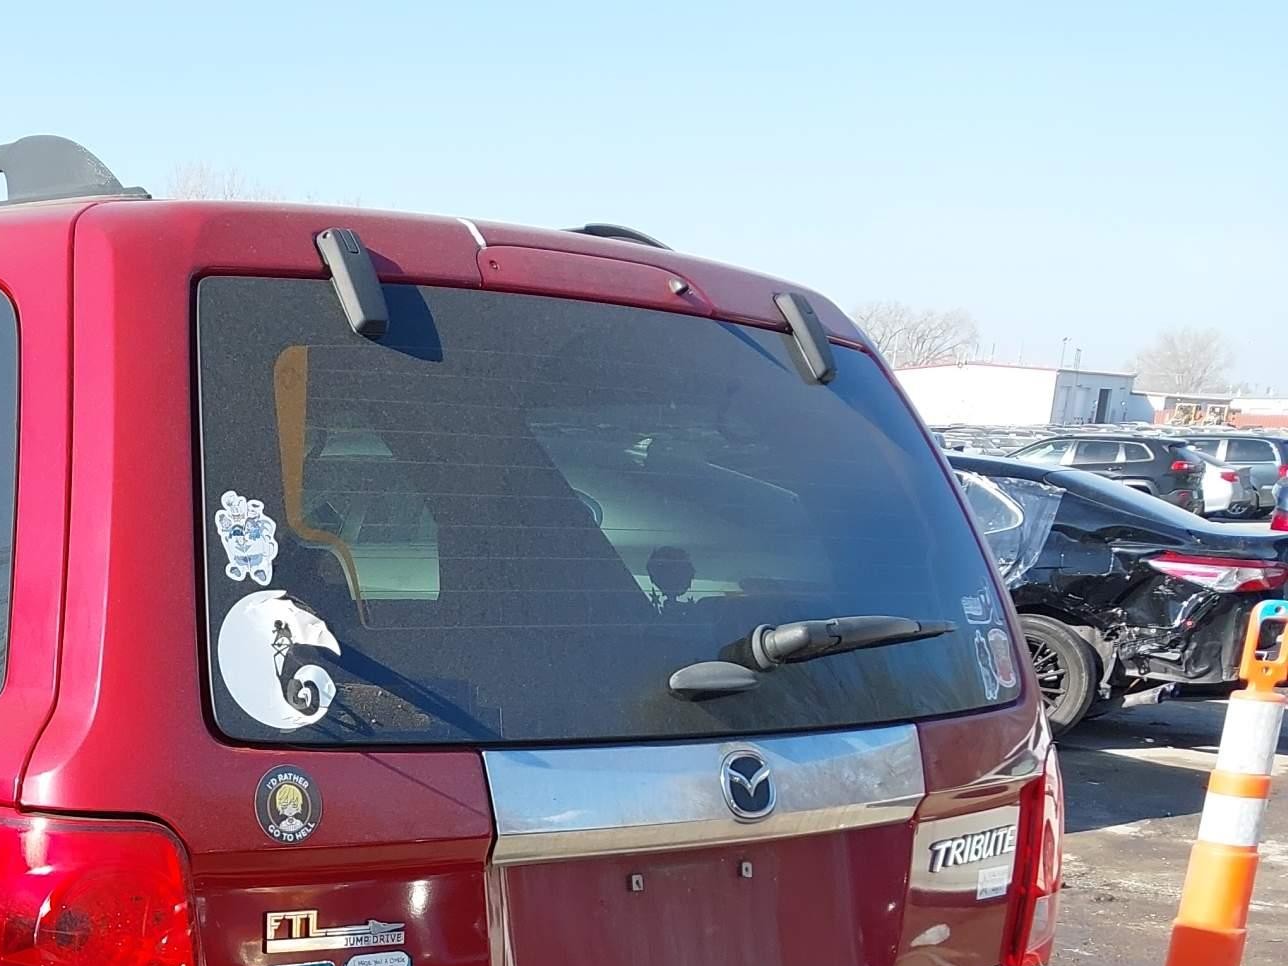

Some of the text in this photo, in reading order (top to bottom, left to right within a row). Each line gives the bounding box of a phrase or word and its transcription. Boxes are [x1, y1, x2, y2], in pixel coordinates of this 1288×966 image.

[266, 773, 309, 789] I'D RATHER
[268, 822, 315, 841] GO TO HELL
[929, 824, 1016, 872] TRIBUTE
[267, 910, 318, 940] FTL
[344, 933, 402, 946] JUMP DRIVE
